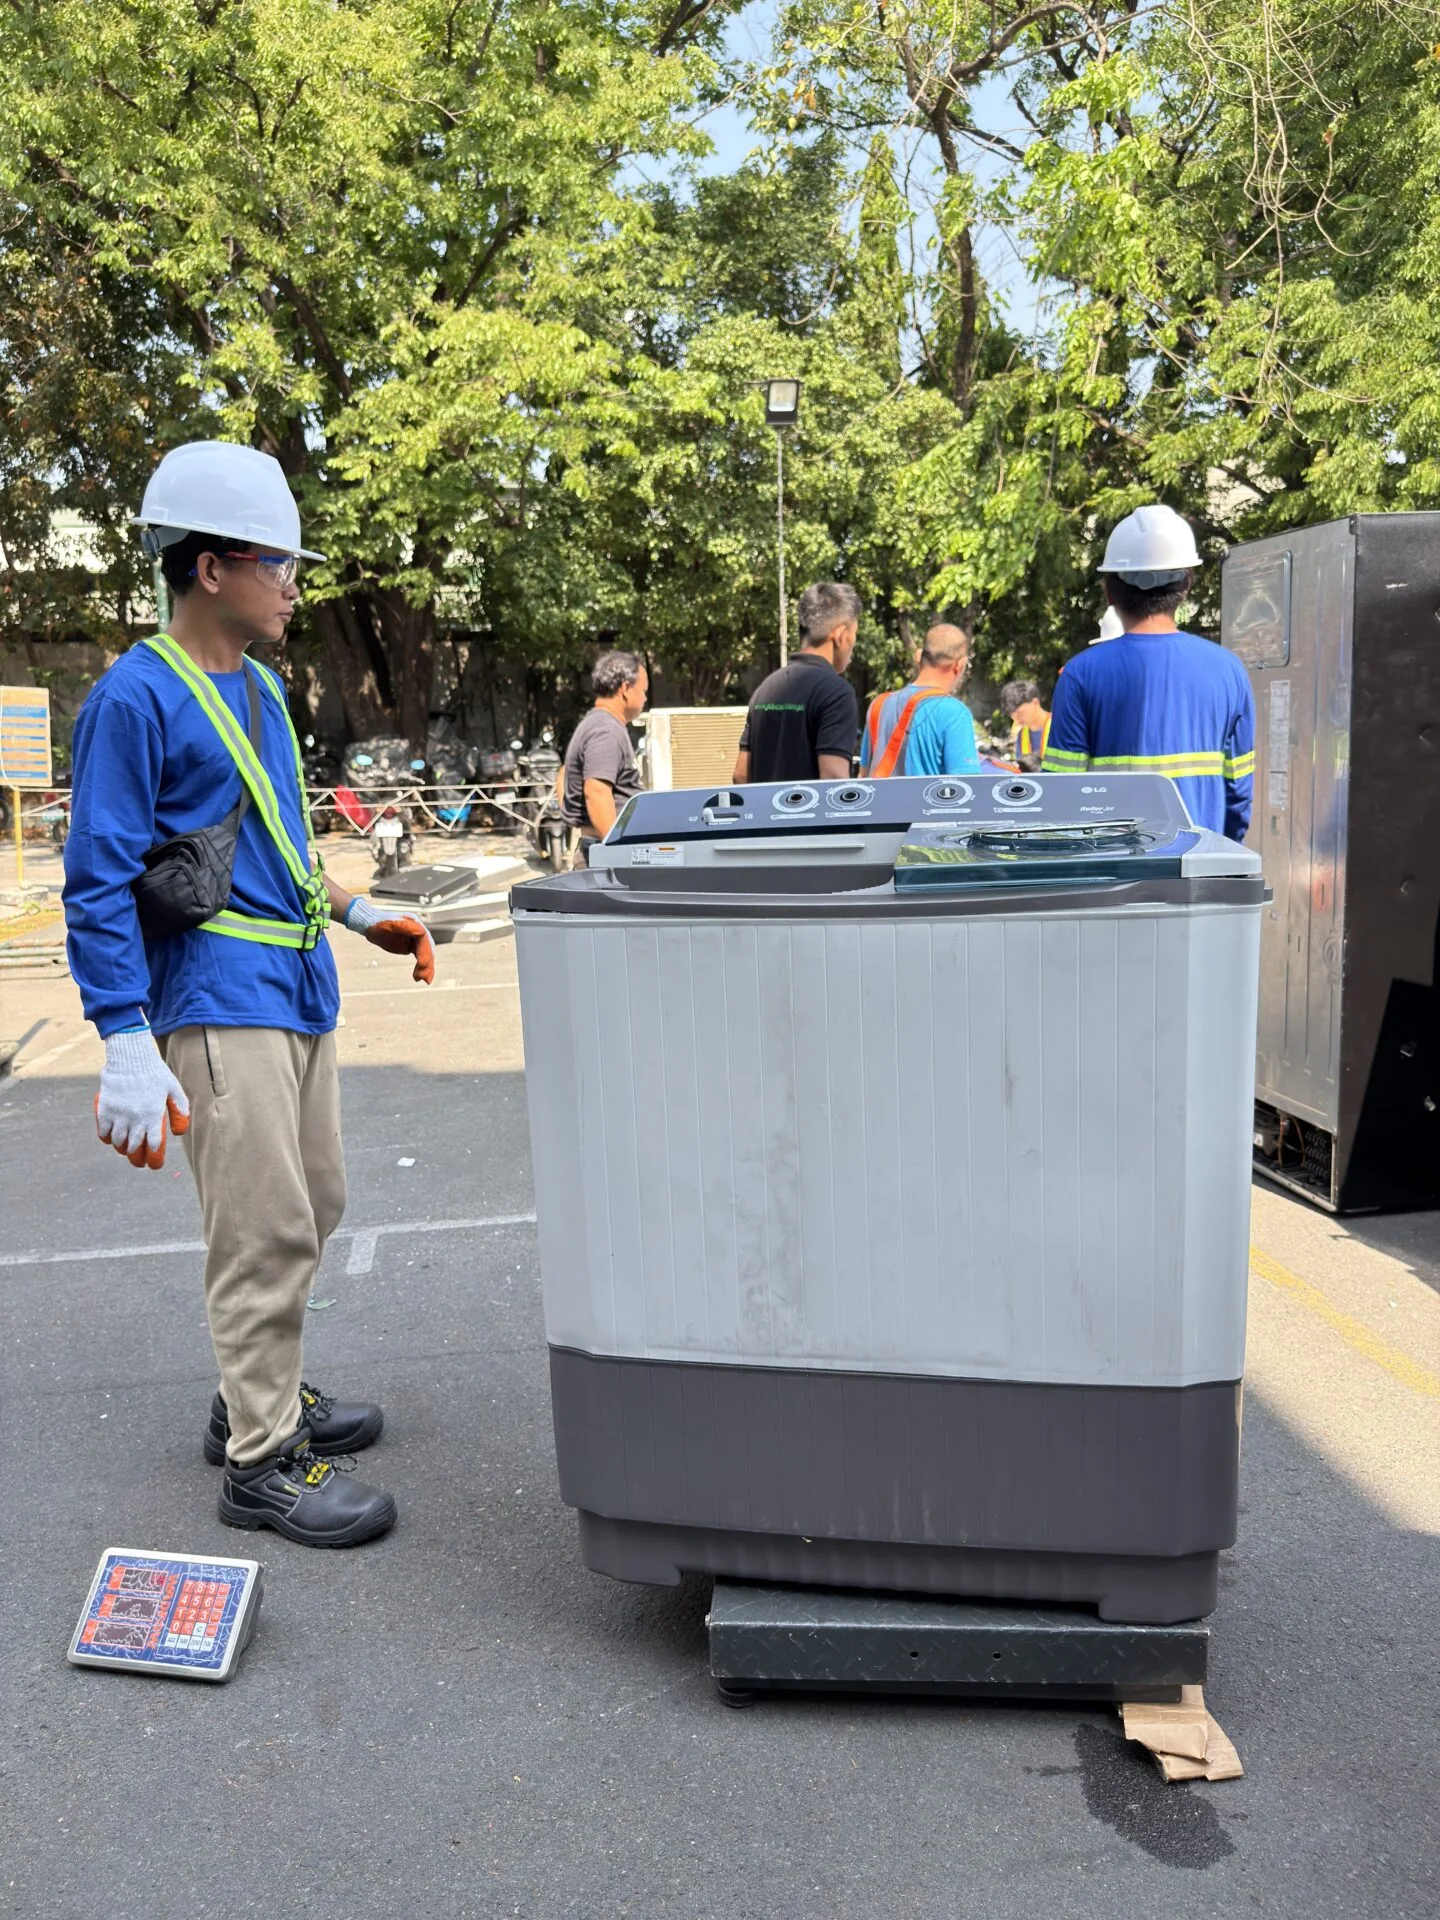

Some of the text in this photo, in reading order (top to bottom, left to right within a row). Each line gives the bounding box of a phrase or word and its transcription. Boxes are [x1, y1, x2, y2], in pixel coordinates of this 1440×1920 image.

[185, 1581, 193, 1594] 7
[197, 1582, 204, 1593] 8
[209, 1583, 216, 1594] 9
[181, 1595, 188, 1605] 4
[193, 1595, 200, 1606] 5
[205, 1597, 213, 1607] 6
[178, 1609, 183, 1618] 1
[188, 1609, 196, 1620] 2
[200, 1610, 208, 1620] 3
[172, 1621, 180, 1632] 0
